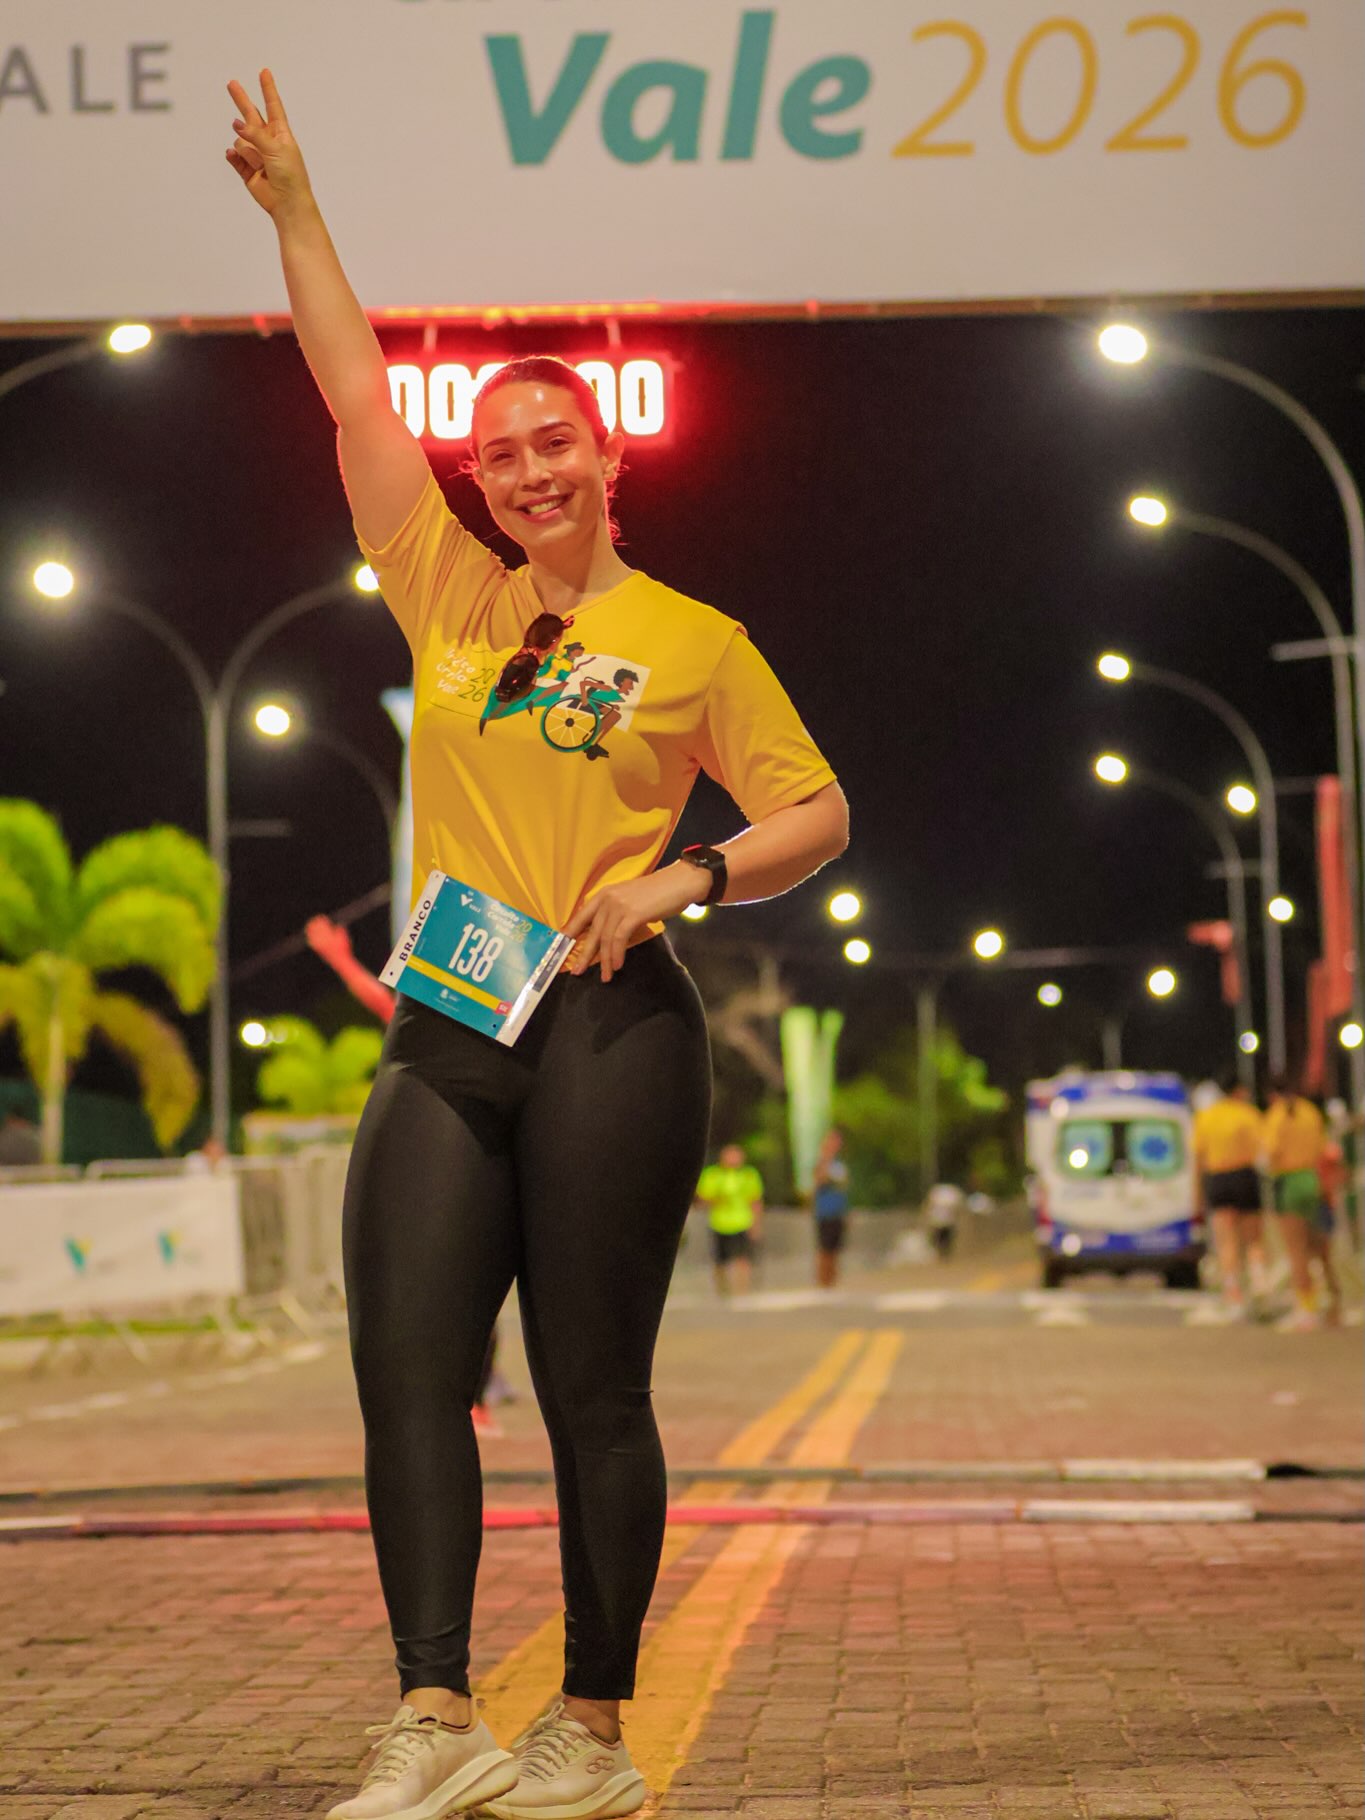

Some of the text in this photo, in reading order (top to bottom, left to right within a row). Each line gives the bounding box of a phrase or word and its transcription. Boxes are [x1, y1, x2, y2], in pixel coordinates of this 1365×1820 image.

[484, 9, 1310, 167] Vale 2026
[398, 899, 432, 962] BRANCO
[448, 922, 505, 983] 138
